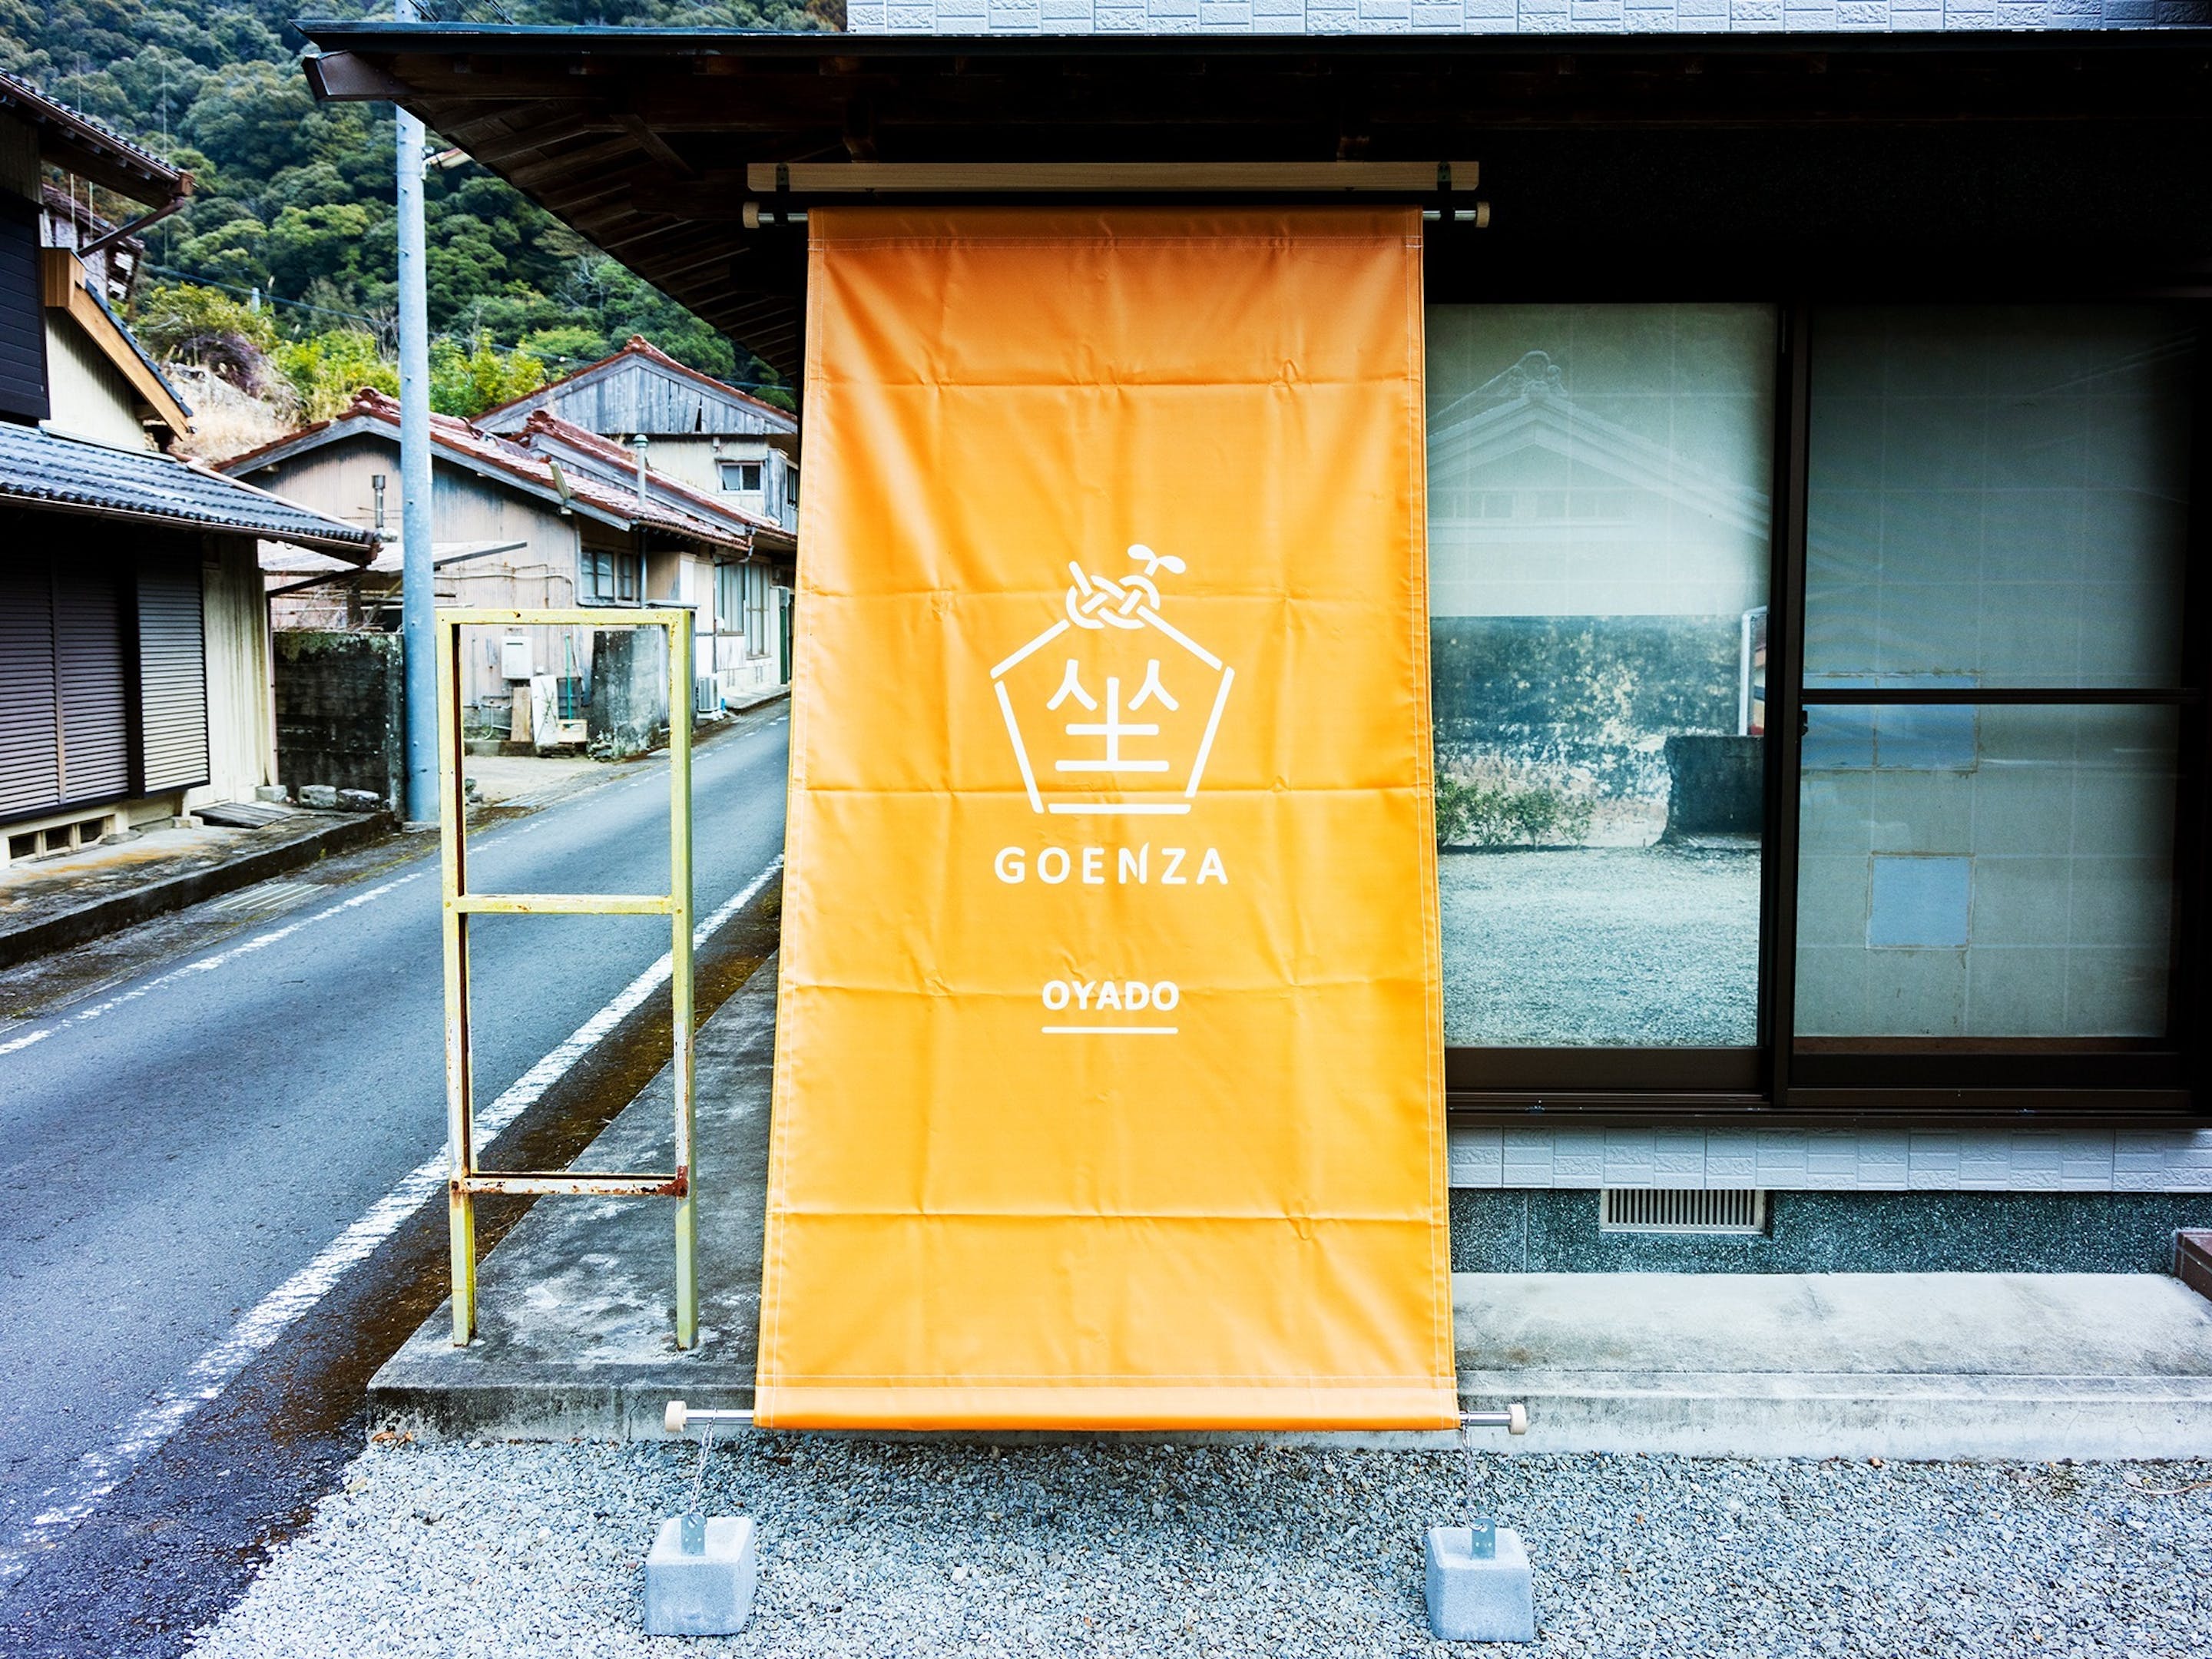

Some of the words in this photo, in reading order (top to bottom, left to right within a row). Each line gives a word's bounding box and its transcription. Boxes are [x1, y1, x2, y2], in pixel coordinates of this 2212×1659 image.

[1046, 658, 1180, 773] 坐
[994, 842, 1228, 885] GOENZA
[1041, 979, 1180, 1012] OYADO
